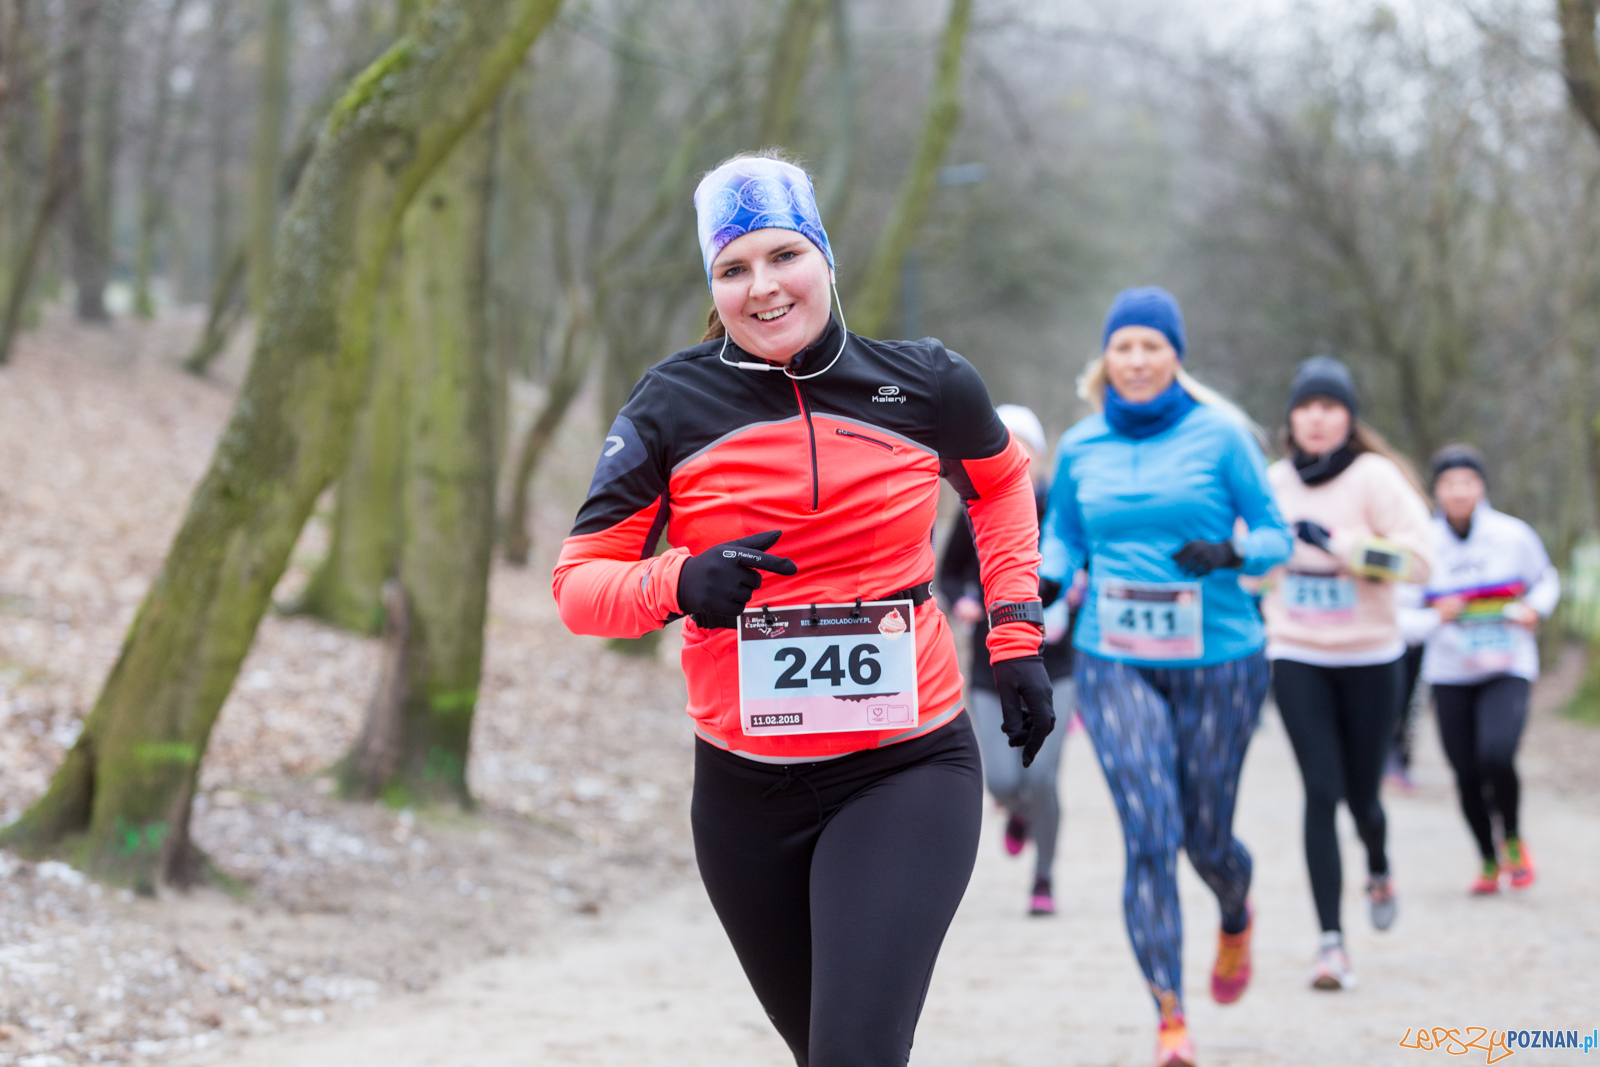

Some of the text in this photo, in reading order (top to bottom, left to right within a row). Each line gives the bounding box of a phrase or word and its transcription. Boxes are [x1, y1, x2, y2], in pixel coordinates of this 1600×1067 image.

[871, 395, 907, 404] Kalenji
[737, 551, 762, 561] Kalenji
[1118, 608, 1176, 632] 411
[774, 643, 882, 689] 246
[753, 714, 800, 725] 11.02.2018
